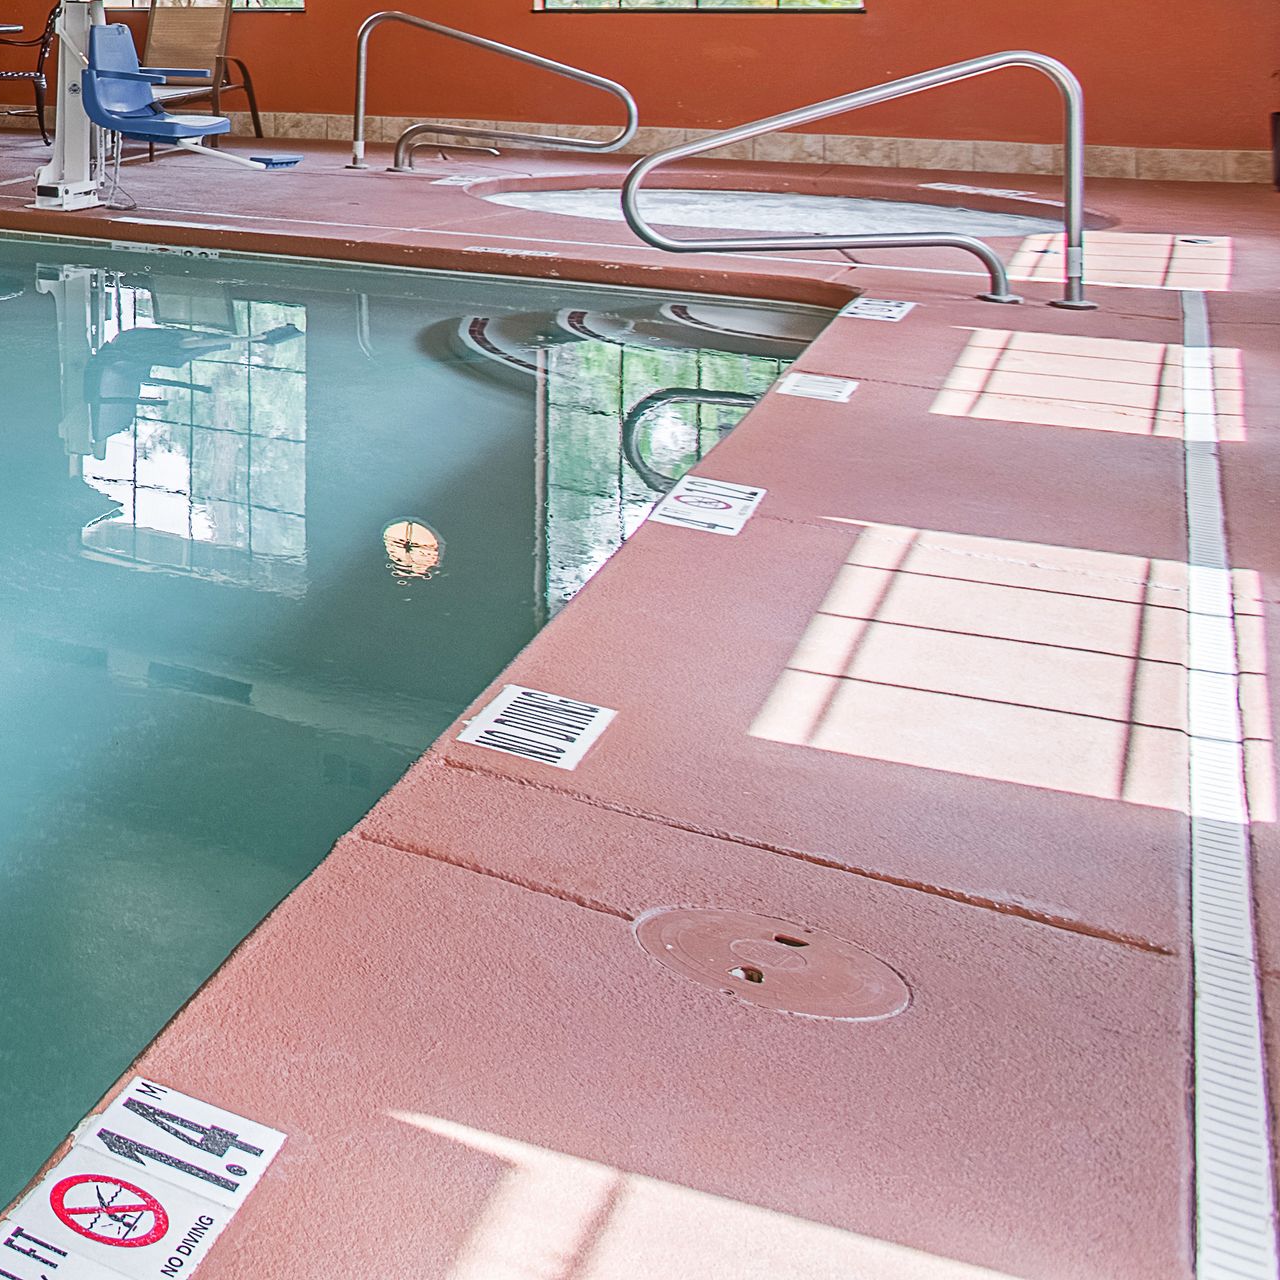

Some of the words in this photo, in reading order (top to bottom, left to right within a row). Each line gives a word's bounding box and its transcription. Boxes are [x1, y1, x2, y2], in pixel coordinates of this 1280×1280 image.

[493, 690, 600, 744] DIVING
[474, 729, 567, 765] NO
[135, 1082, 168, 1101] M
[96, 1096, 265, 1193] 1.4
[2, 1225, 69, 1270] FT
[160, 1255, 184, 1279] NO
[175, 1215, 215, 1257] DIVING
